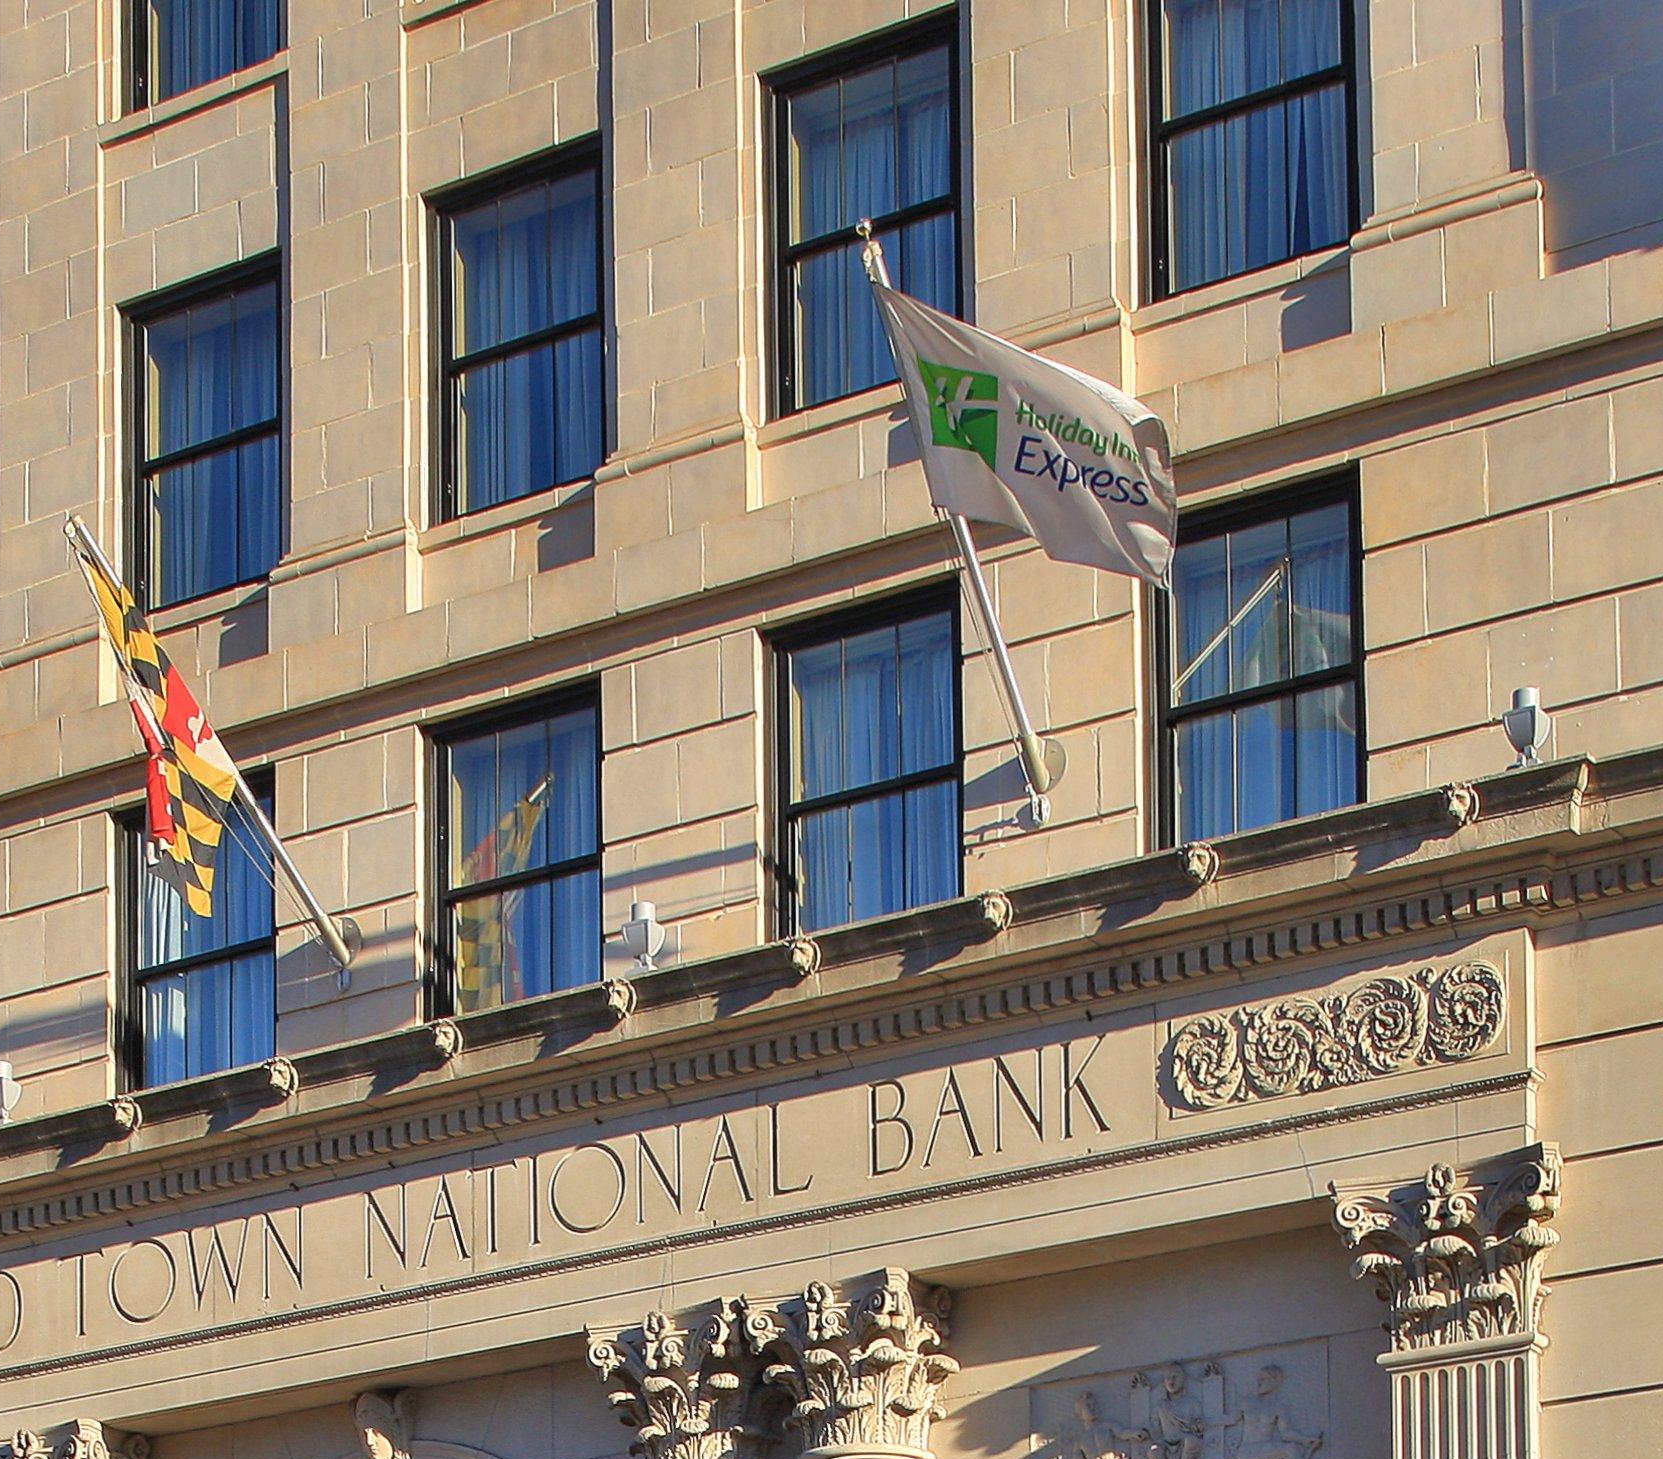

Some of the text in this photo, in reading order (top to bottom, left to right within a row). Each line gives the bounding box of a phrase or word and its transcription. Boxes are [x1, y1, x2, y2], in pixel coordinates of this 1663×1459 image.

[1015, 399, 1109, 457] Holiday
[1014, 435, 1149, 506] Express
[57, 1205, 306, 1338] TOWN
[363, 1103, 814, 1279] NATIONAL
[864, 1035, 1112, 1179] BANK
